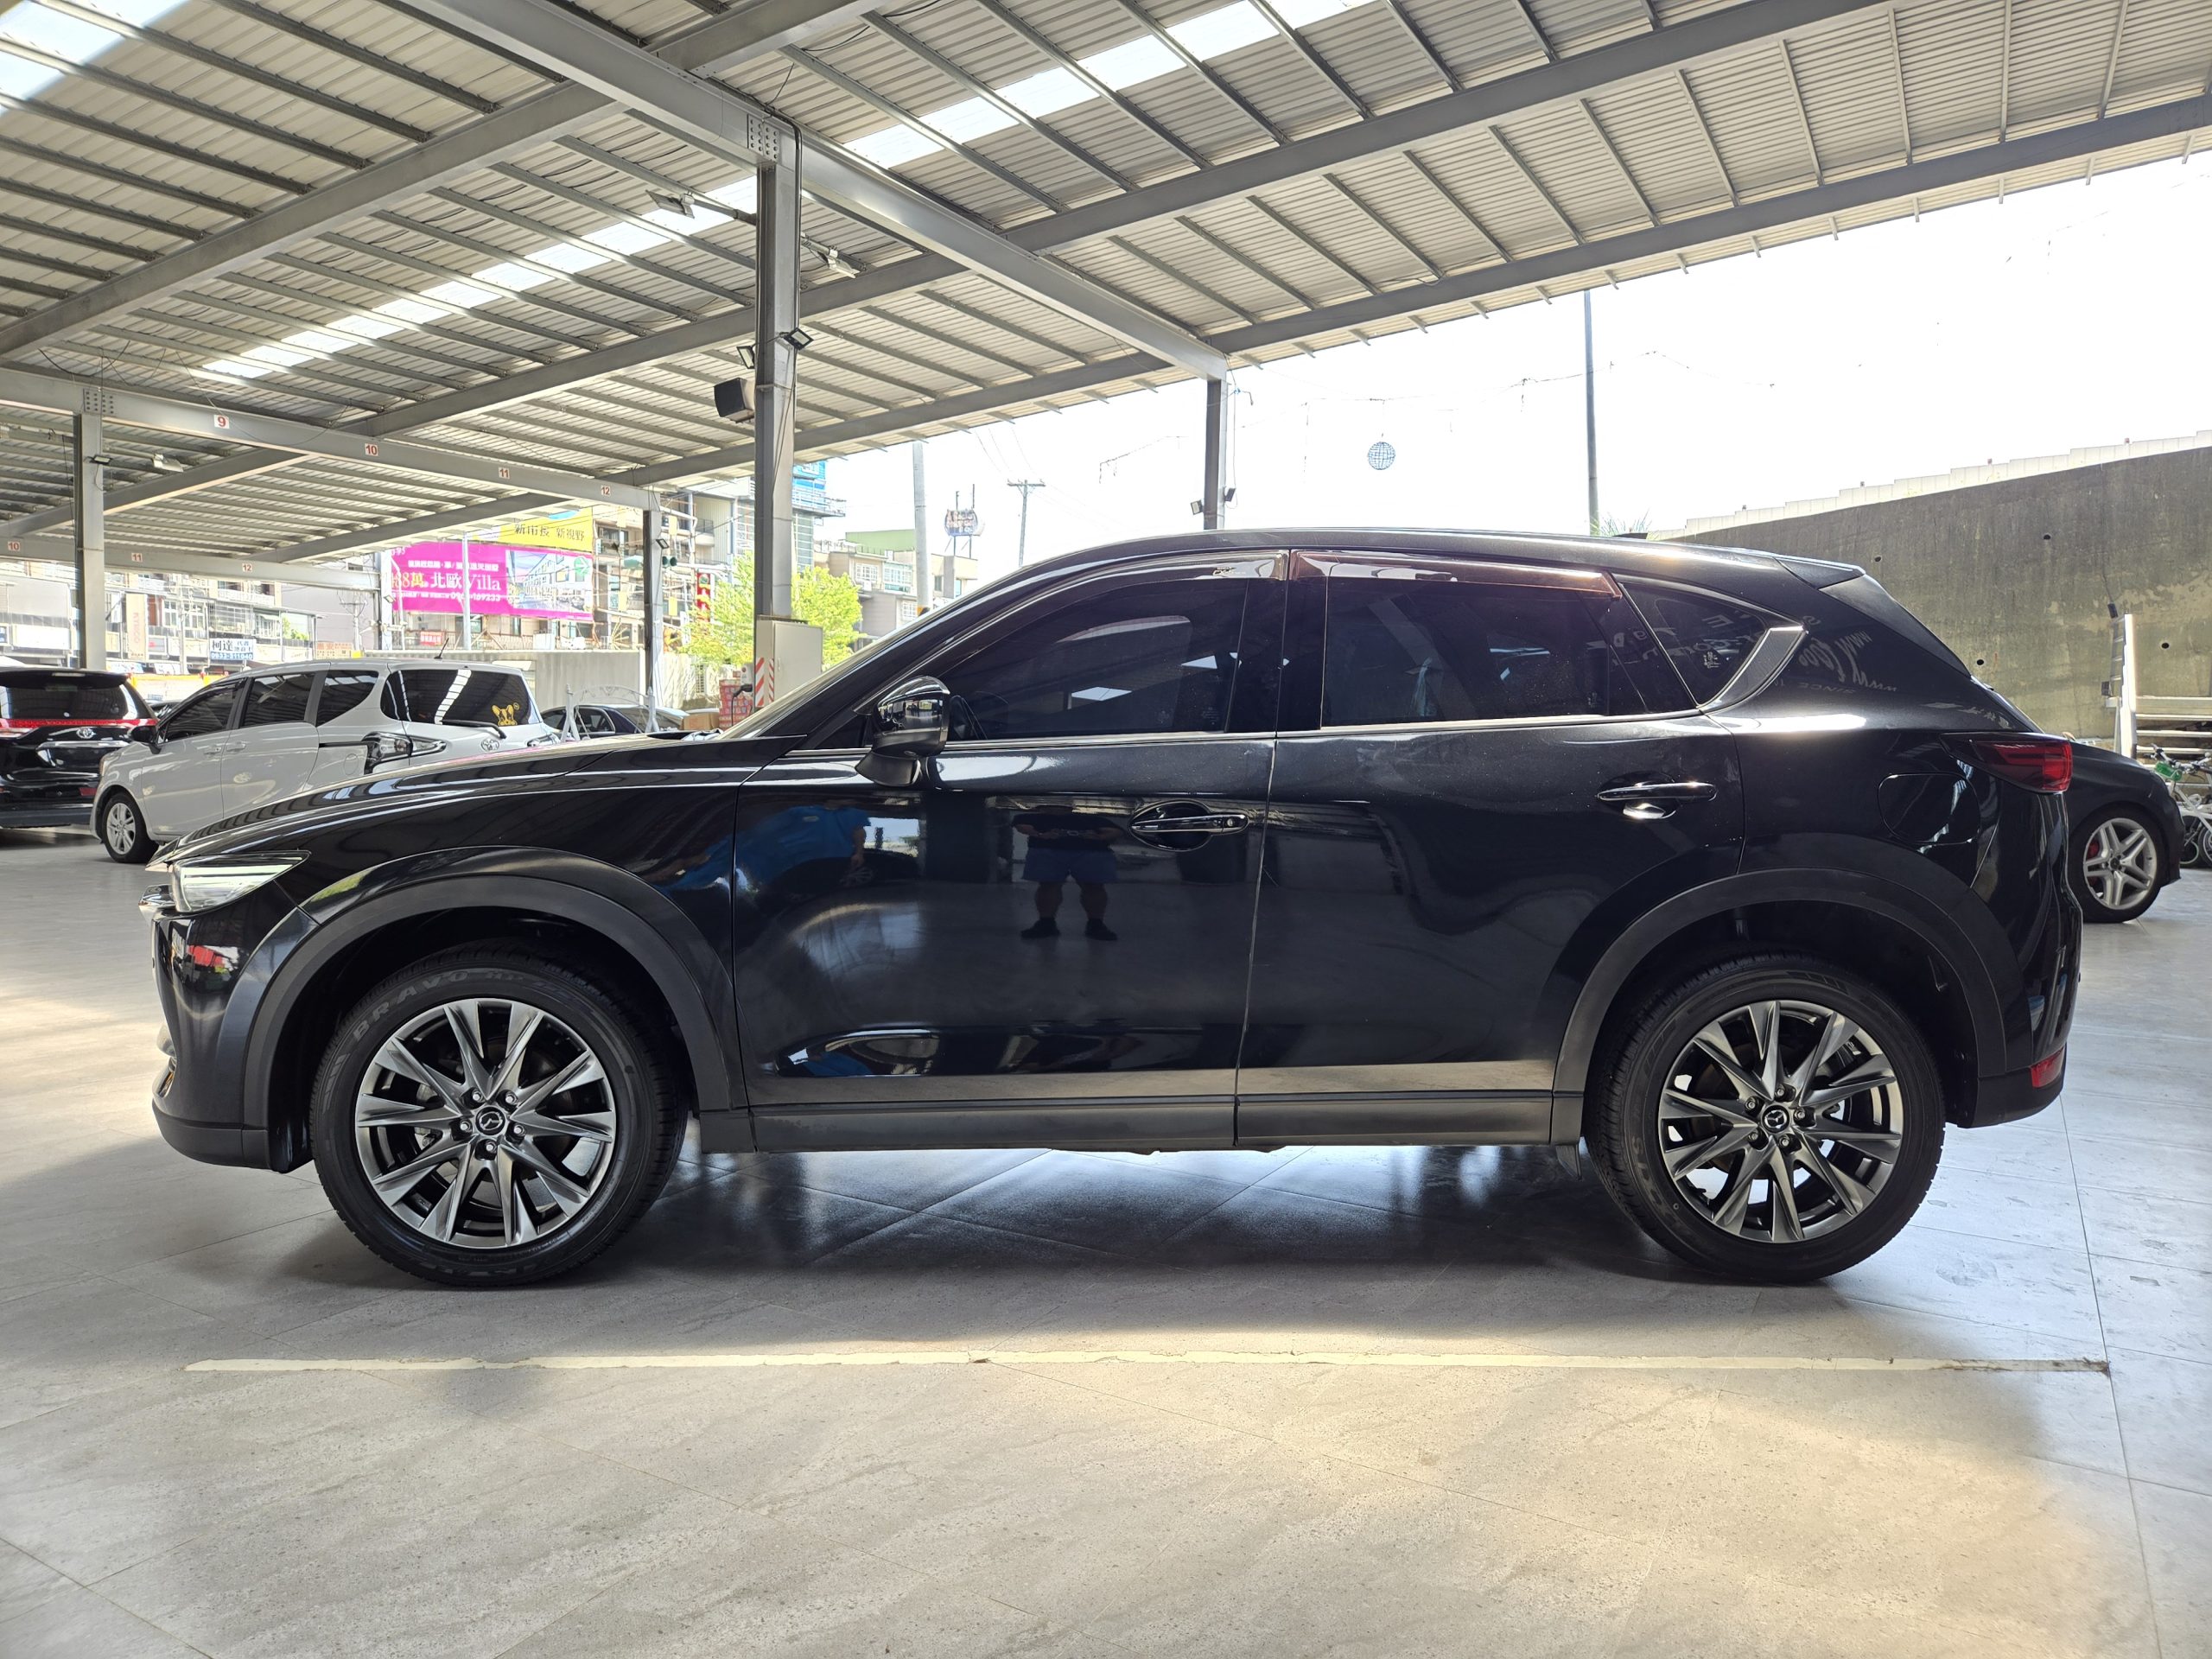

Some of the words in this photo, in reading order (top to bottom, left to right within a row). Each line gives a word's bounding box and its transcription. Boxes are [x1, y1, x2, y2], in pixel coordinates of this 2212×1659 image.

[217, 416, 226, 428] 9
[365, 443, 378, 455] 10
[499, 468, 509, 478] 11
[601, 486, 610, 495] 12
[515, 524, 550, 537] 新市長
[8, 542, 21, 551] 10
[430, 572, 462, 589] 北歐
[354, 970, 468, 1039] BRAVO
